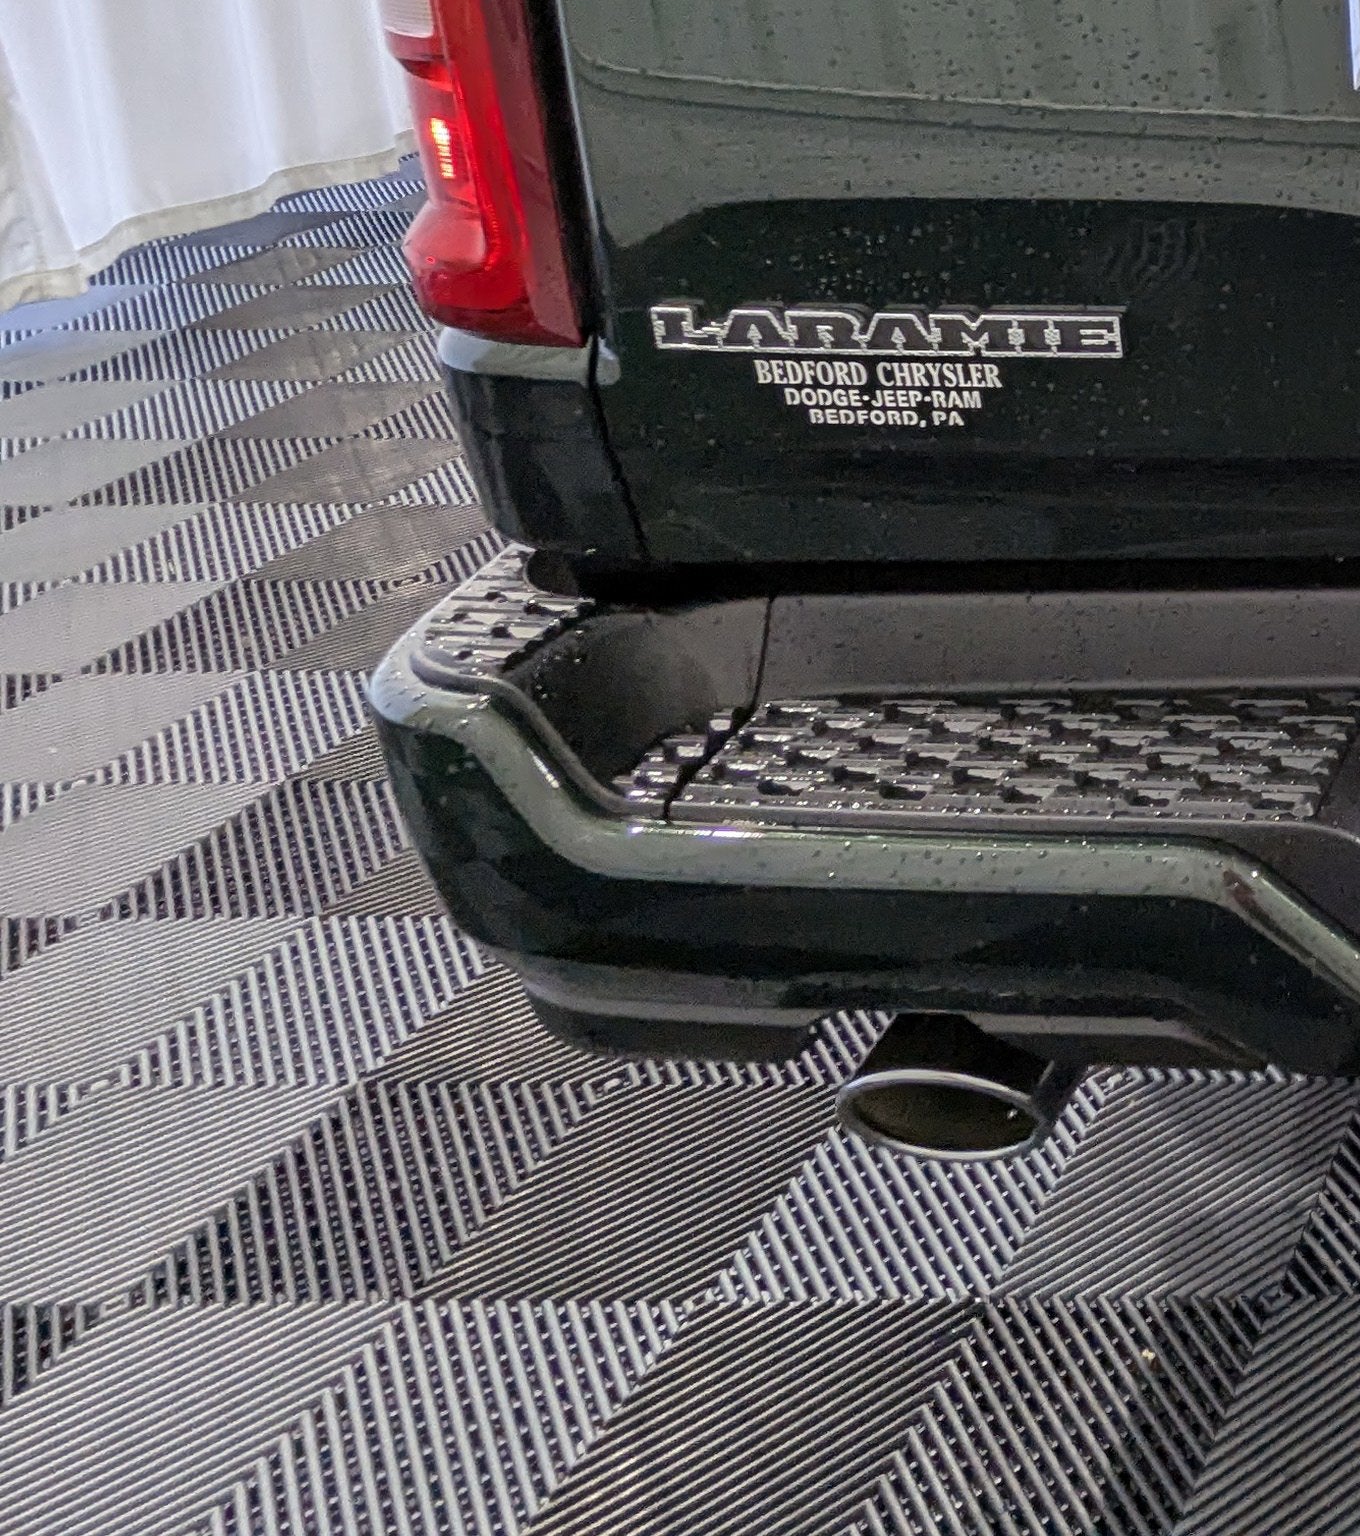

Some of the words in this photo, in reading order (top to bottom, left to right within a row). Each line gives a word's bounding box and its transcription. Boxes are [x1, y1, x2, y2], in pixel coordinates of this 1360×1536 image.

[648, 304, 1125, 359] LARAMIE
[754, 360, 867, 387] BEDFORD
[876, 362, 1003, 389] CHRYSLER
[809, 408, 927, 428] BEDFORD,
[932, 411, 965, 427] PA
